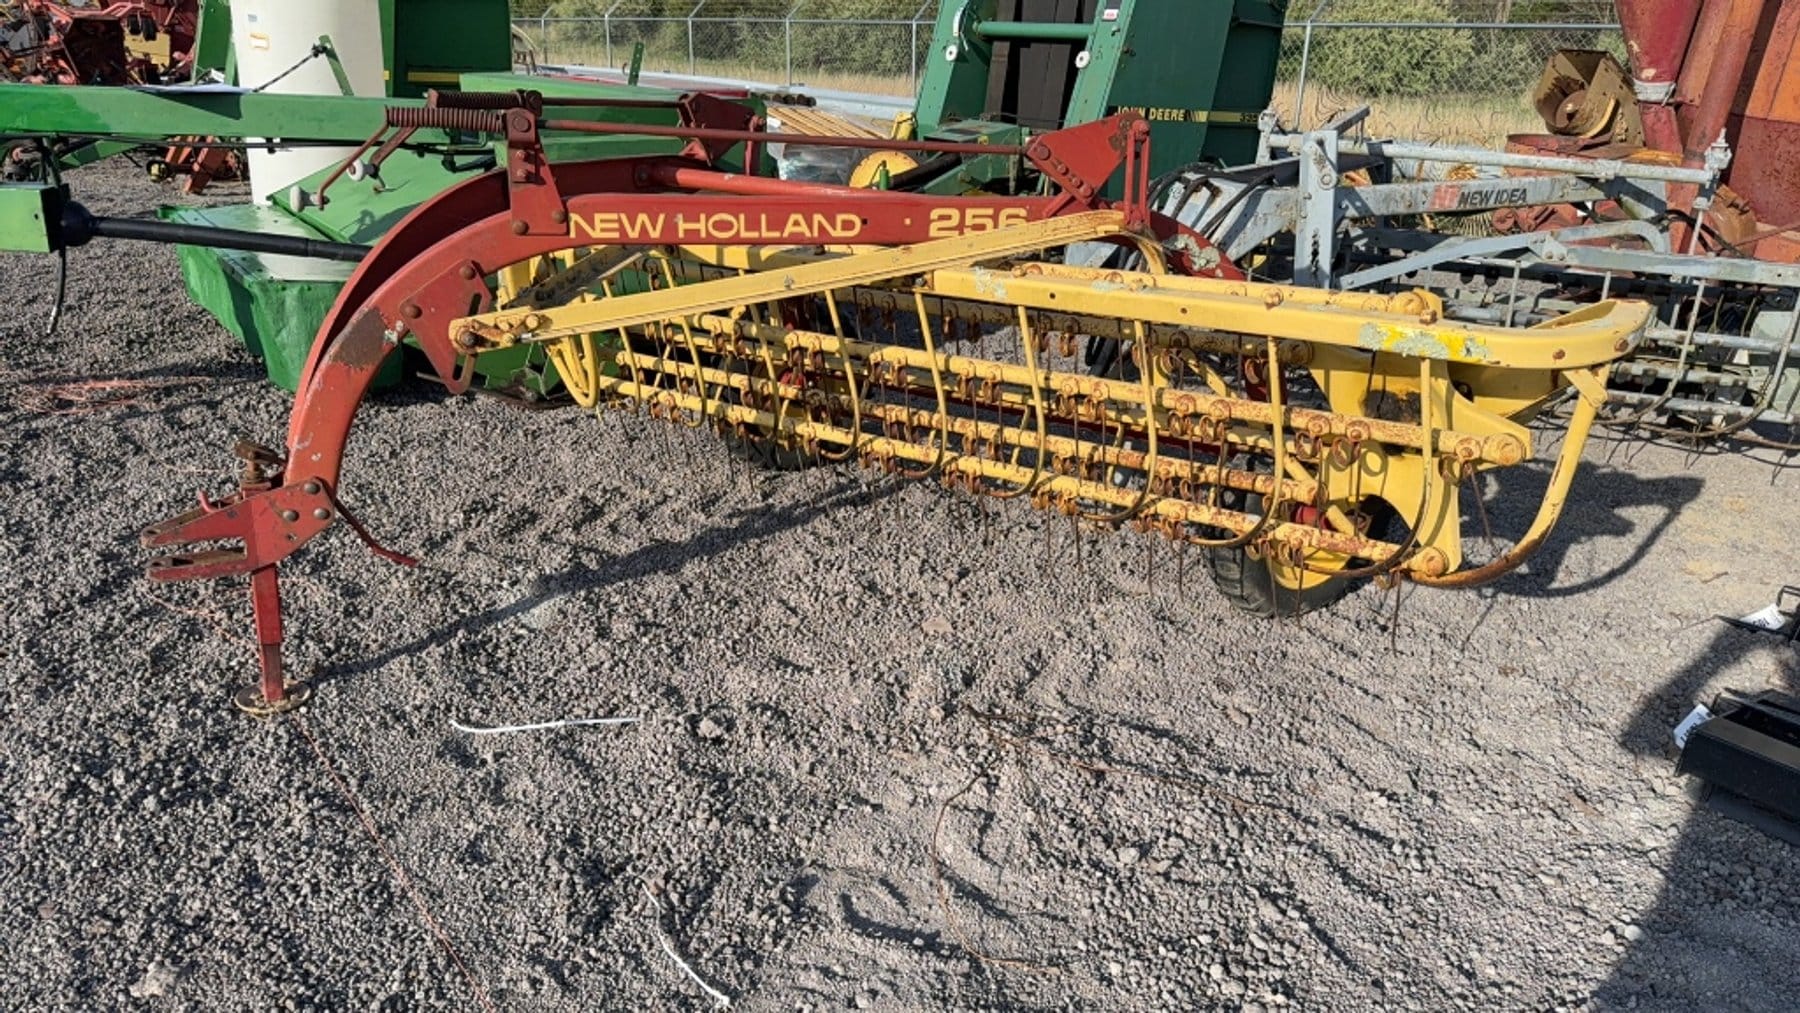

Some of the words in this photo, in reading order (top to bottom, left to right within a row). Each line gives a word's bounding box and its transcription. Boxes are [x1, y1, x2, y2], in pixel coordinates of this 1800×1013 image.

[1148, 107, 1186, 121] DEERE
[1456, 190, 1495, 209] NEW
[1494, 188, 1528, 204] IDEA
[568, 212, 666, 239] NEW
[676, 212, 862, 239] HOLLAND
[929, 207, 1028, 238] 256
